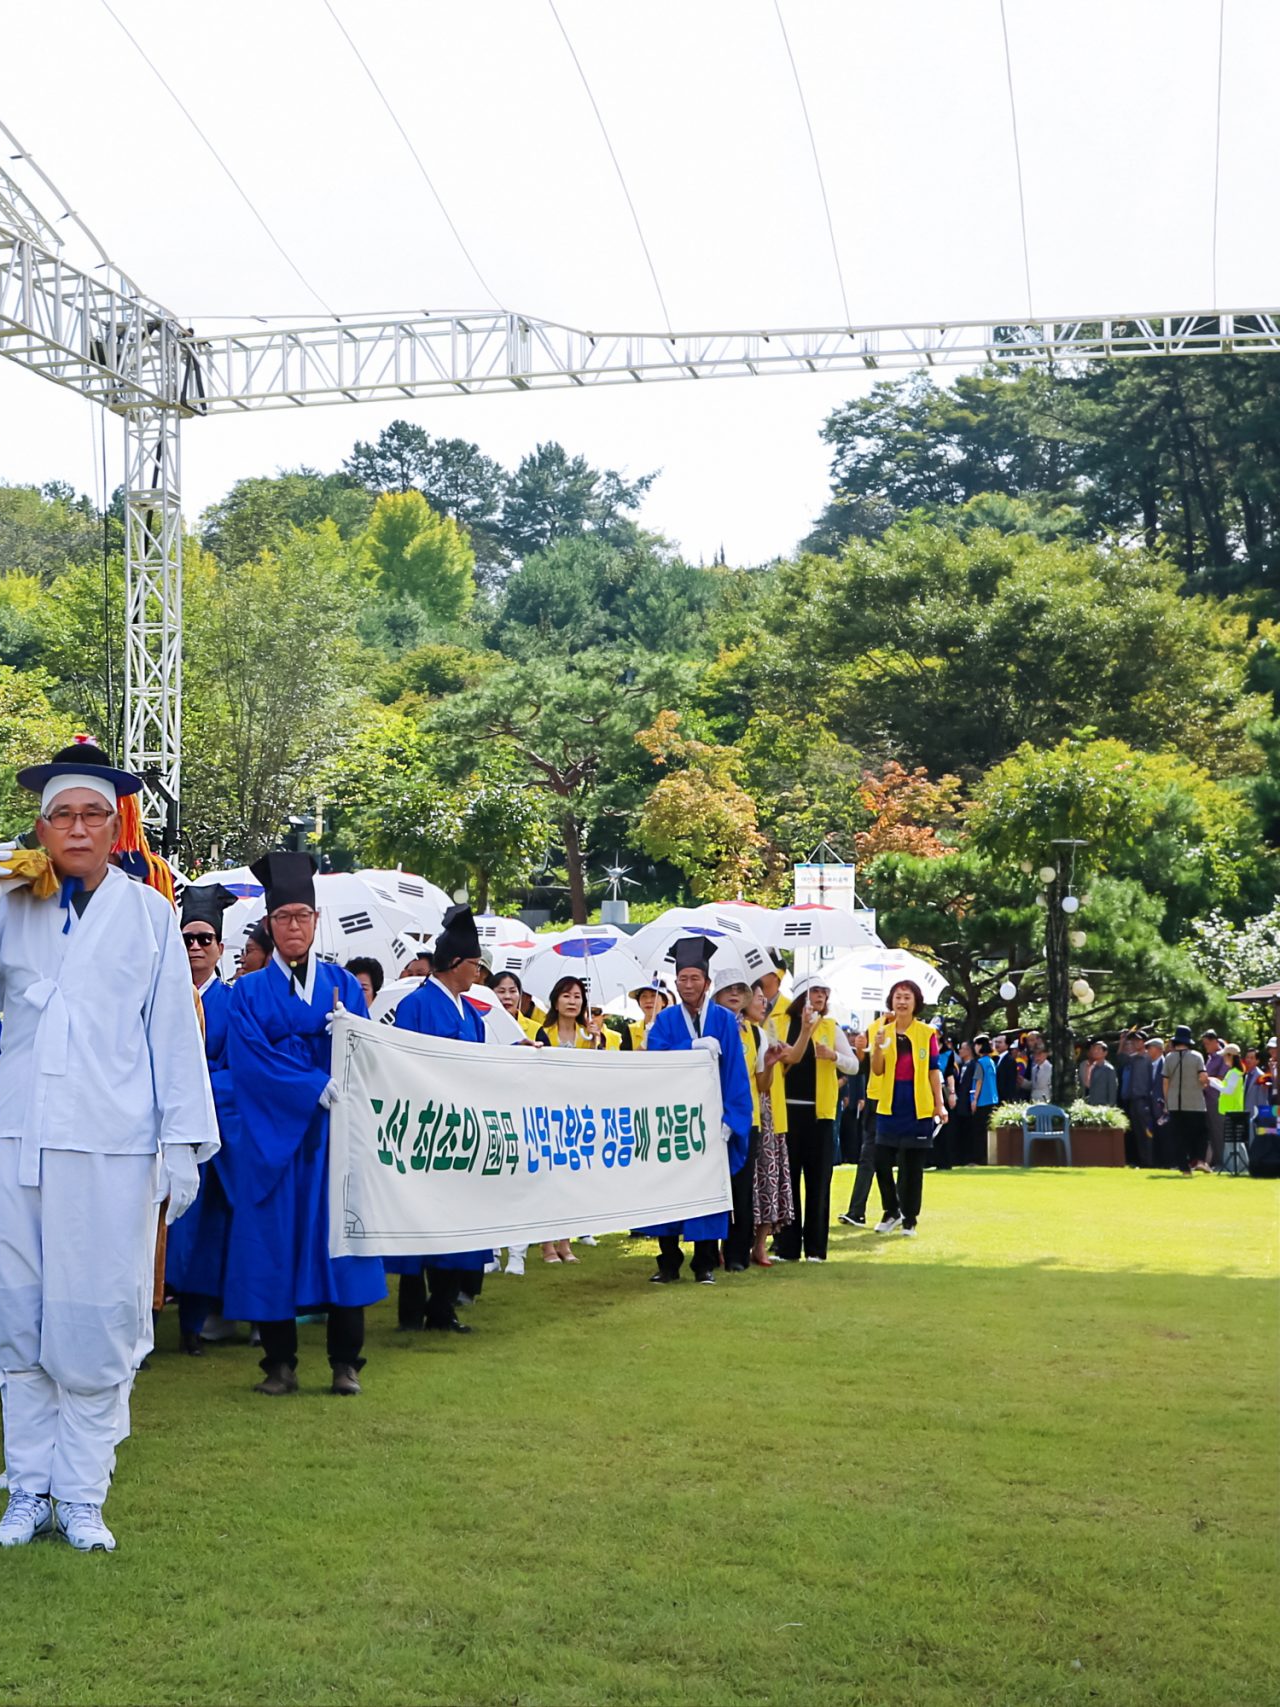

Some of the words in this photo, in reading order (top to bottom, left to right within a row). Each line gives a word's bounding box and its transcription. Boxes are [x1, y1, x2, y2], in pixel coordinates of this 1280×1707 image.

[410, 1099, 481, 1173] 최초의
[481, 1110, 520, 1176] 國母
[522, 1103, 595, 1174] 신덕고황후
[601, 1106, 650, 1169] 정릉에
[655, 1102, 706, 1163] 잠들다
